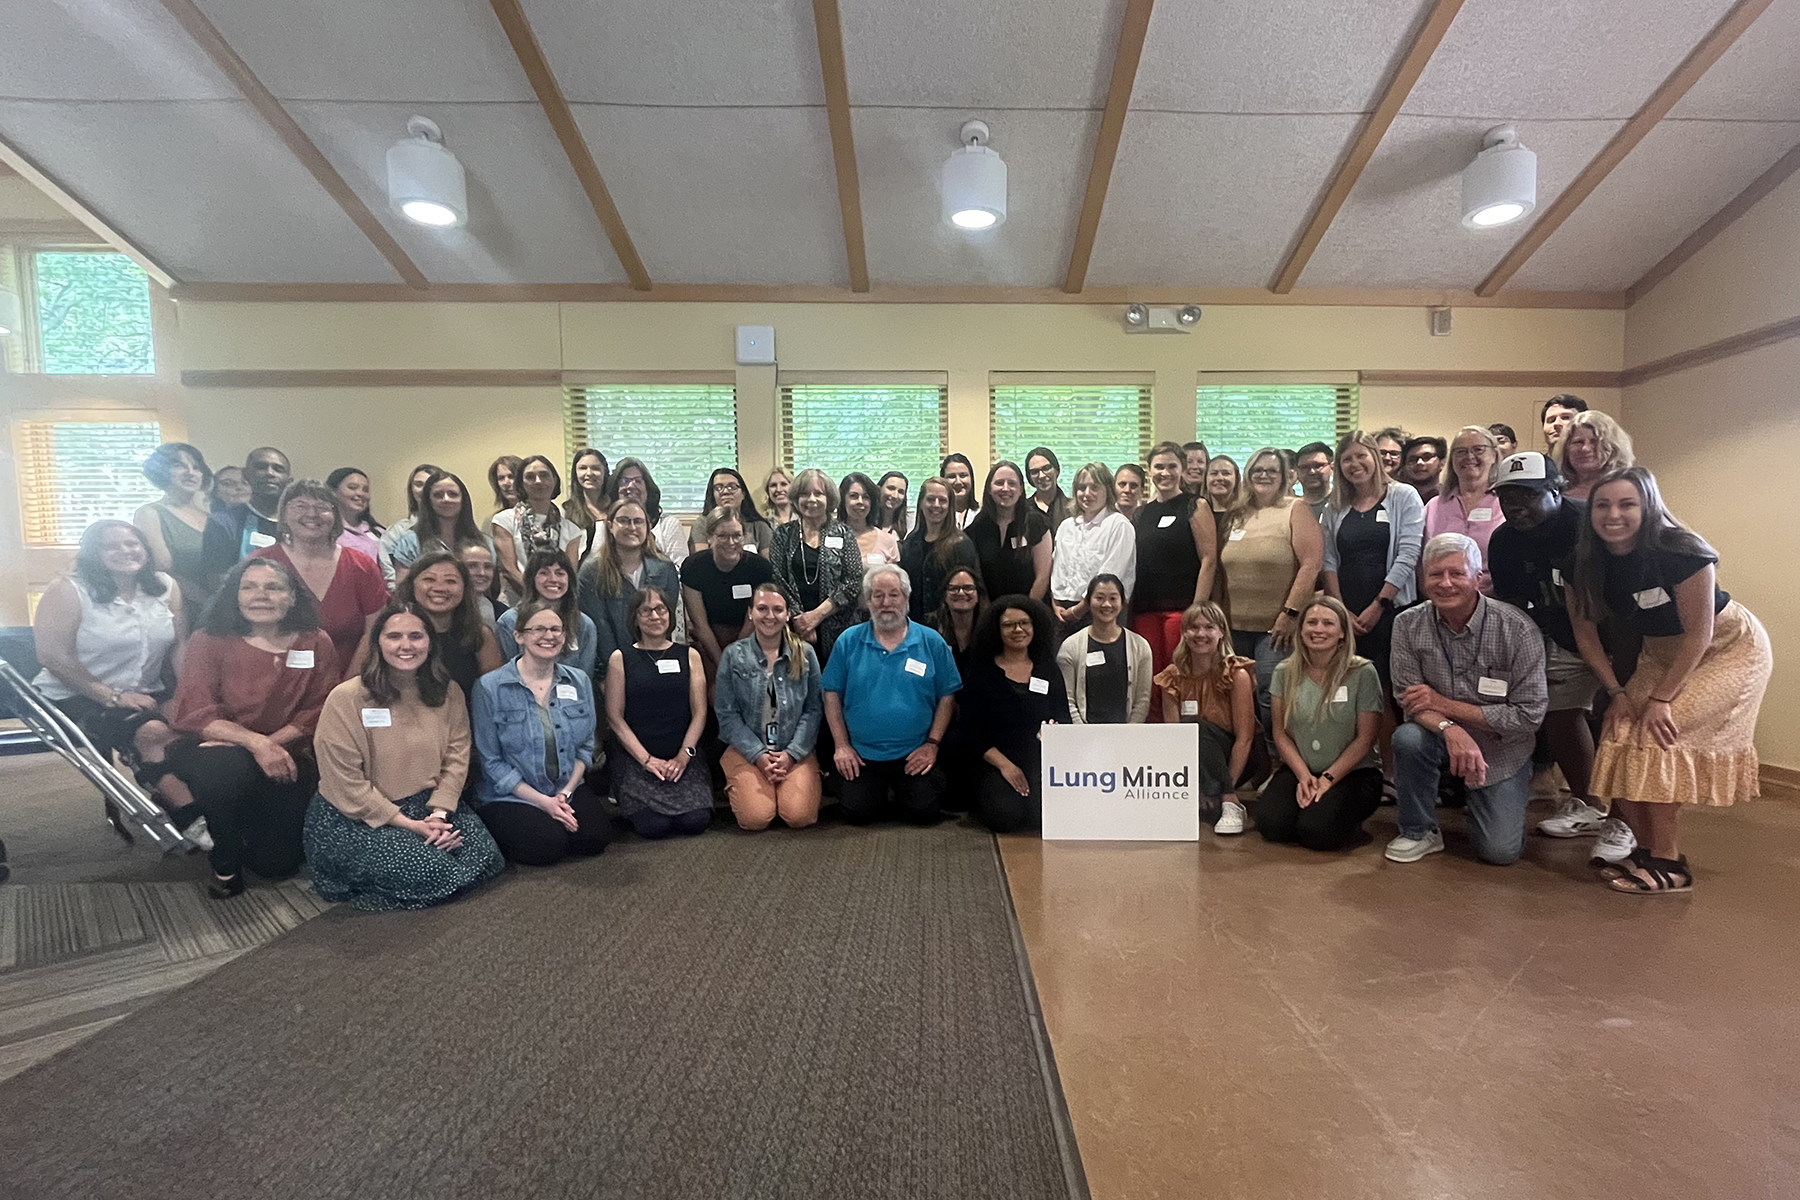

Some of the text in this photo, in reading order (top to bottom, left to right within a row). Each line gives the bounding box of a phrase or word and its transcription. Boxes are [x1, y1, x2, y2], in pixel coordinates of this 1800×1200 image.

[1049, 766, 1189, 793] Lung Mind
[1124, 789, 1189, 800] Alliance
